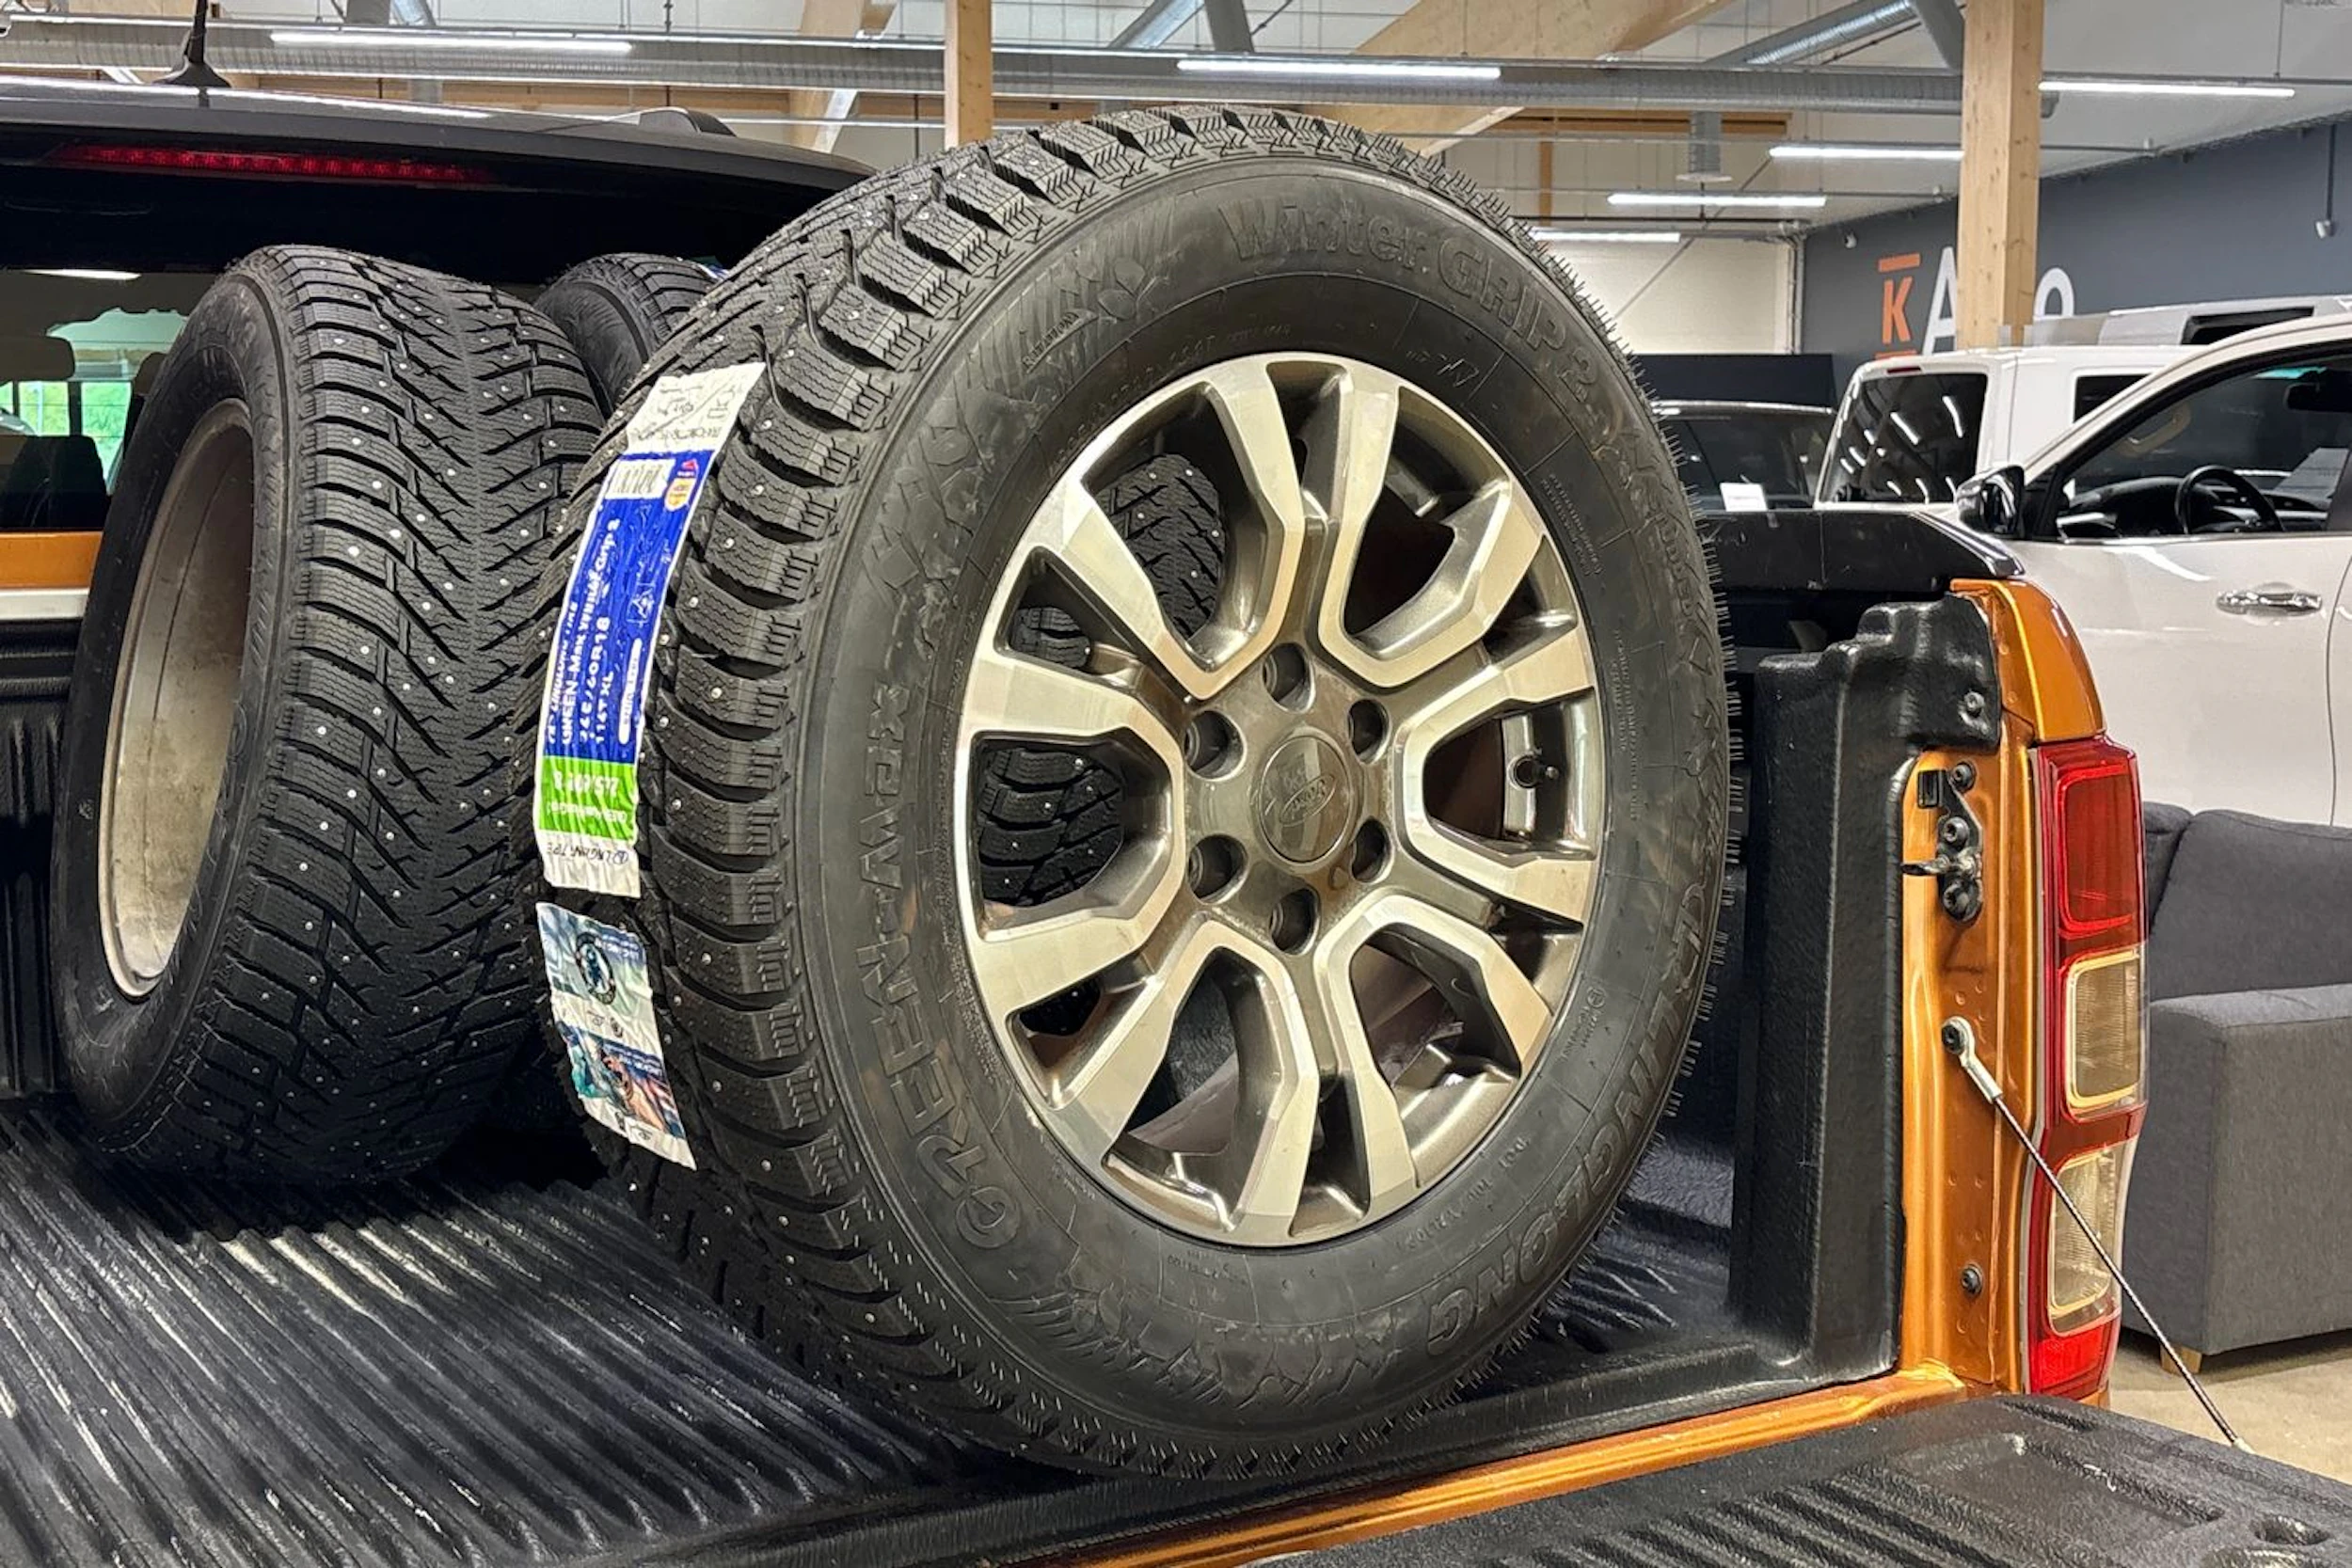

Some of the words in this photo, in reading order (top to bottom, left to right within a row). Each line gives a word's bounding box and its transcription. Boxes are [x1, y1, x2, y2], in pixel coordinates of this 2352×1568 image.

[1438, 236, 1567, 354] GRIP
[1558, 351, 1597, 404] 2
[1882, 276, 1914, 345] K
[1427, 990, 1690, 1354] LINGLONG
